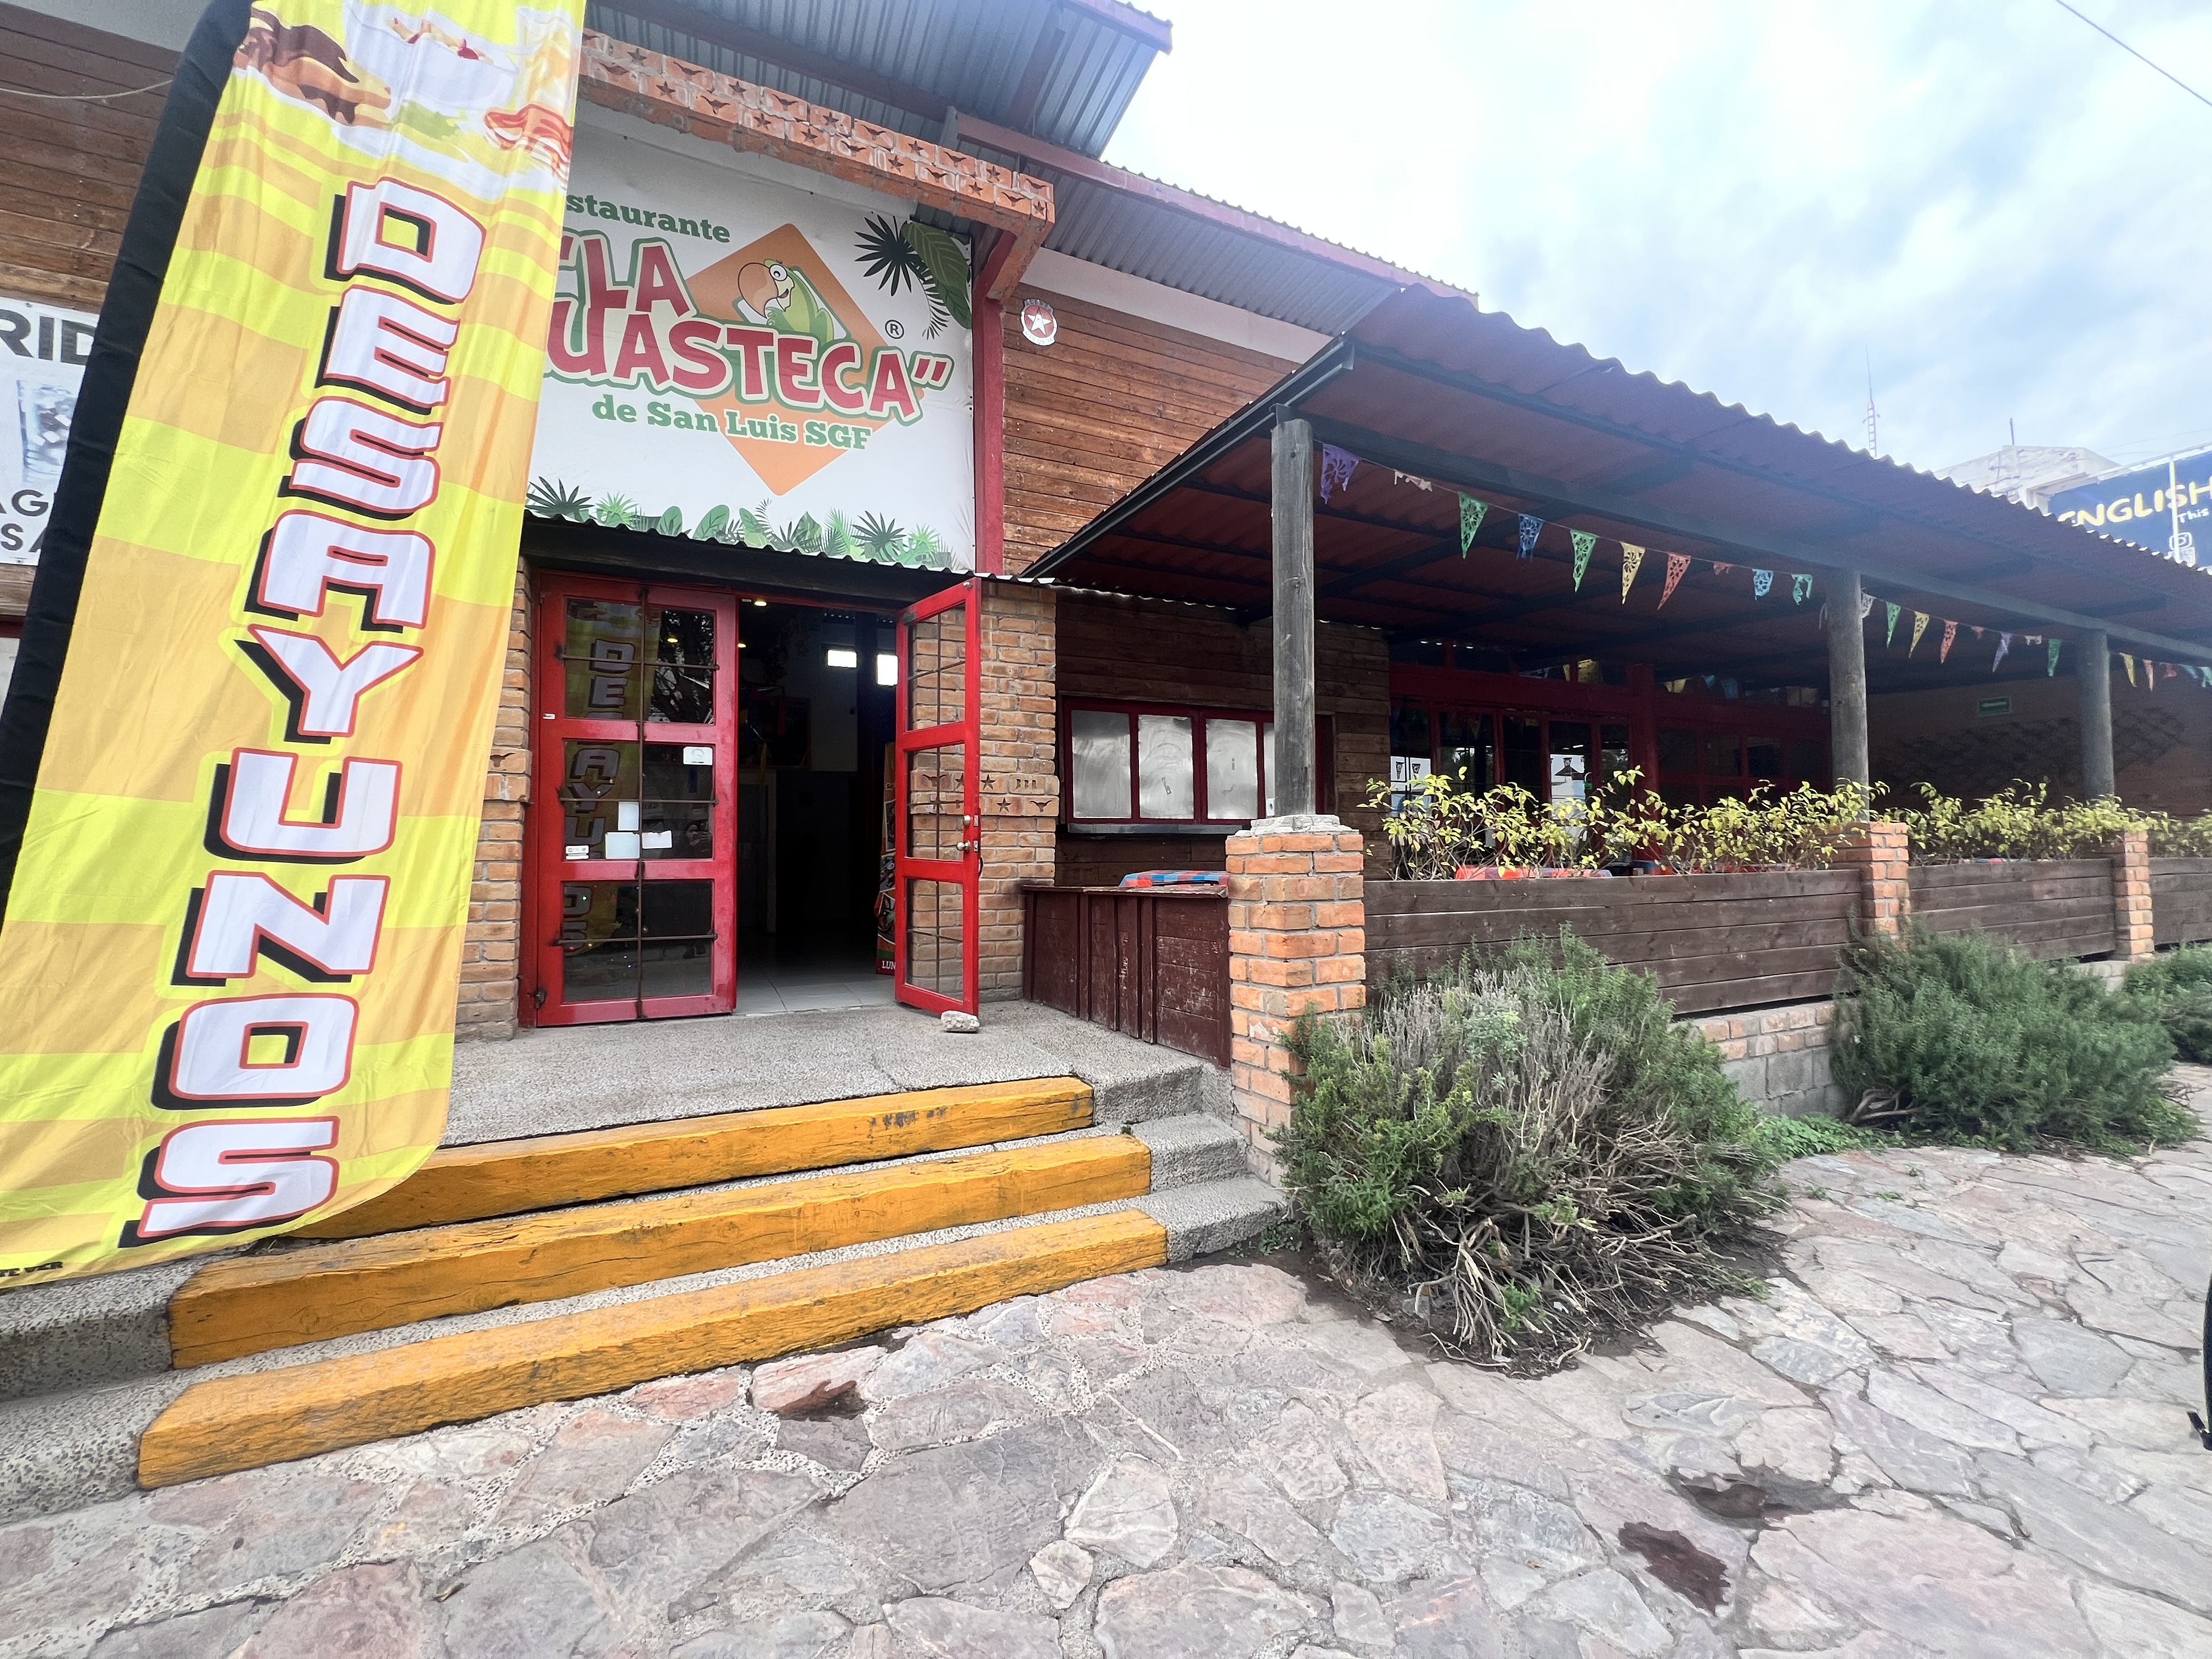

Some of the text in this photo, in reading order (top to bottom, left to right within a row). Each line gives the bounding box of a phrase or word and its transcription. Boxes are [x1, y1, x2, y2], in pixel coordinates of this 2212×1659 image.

[592, 394, 871, 449] de San Luis SGF
[0, 487, 48, 517] G
[118, 177, 487, 1248] DESAYUNOS
